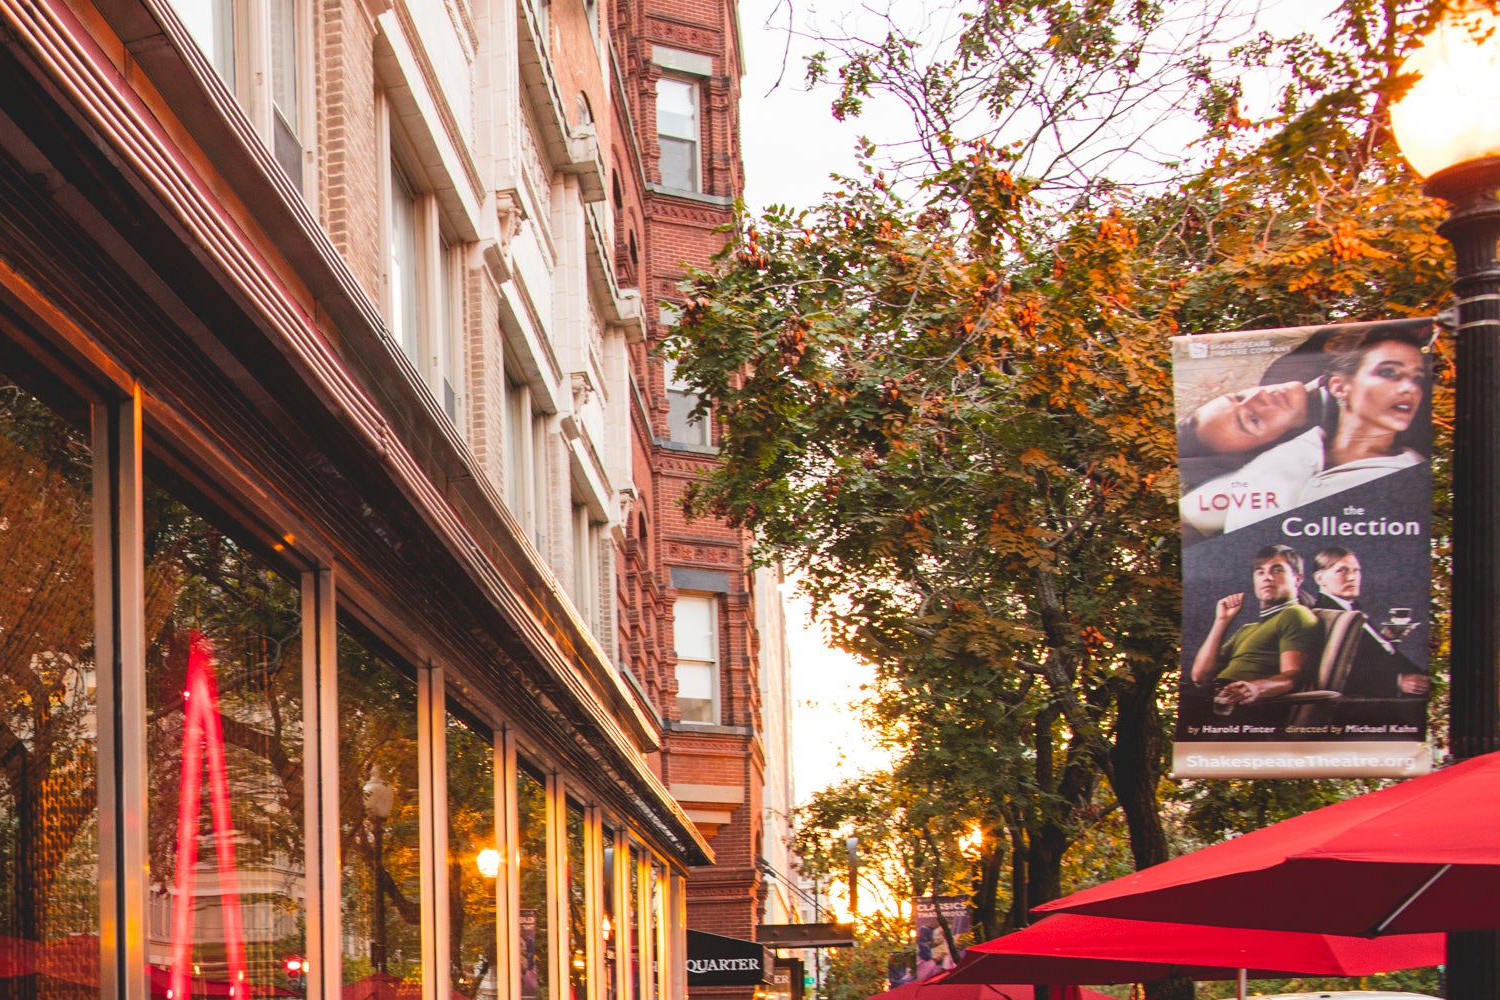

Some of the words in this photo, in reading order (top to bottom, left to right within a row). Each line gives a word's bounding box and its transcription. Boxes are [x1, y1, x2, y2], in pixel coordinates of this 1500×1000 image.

[1231, 480, 1248, 488] the
[1199, 492, 1279, 511] LOVER
[1343, 506, 1365, 516] the
[1282, 517, 1420, 536] Collection
[1188, 726, 1198, 734] by
[1203, 725, 1239, 733] Harold
[1243, 725, 1275, 733] Pinter
[1285, 725, 1328, 733] directed
[1331, 726, 1342, 734] by
[1345, 724, 1386, 733] Michael
[1389, 724, 1418, 733] Kahn
[1186, 755, 1416, 769] ShakespeareTheatre.org
[687, 958, 760, 974] QUARTER
